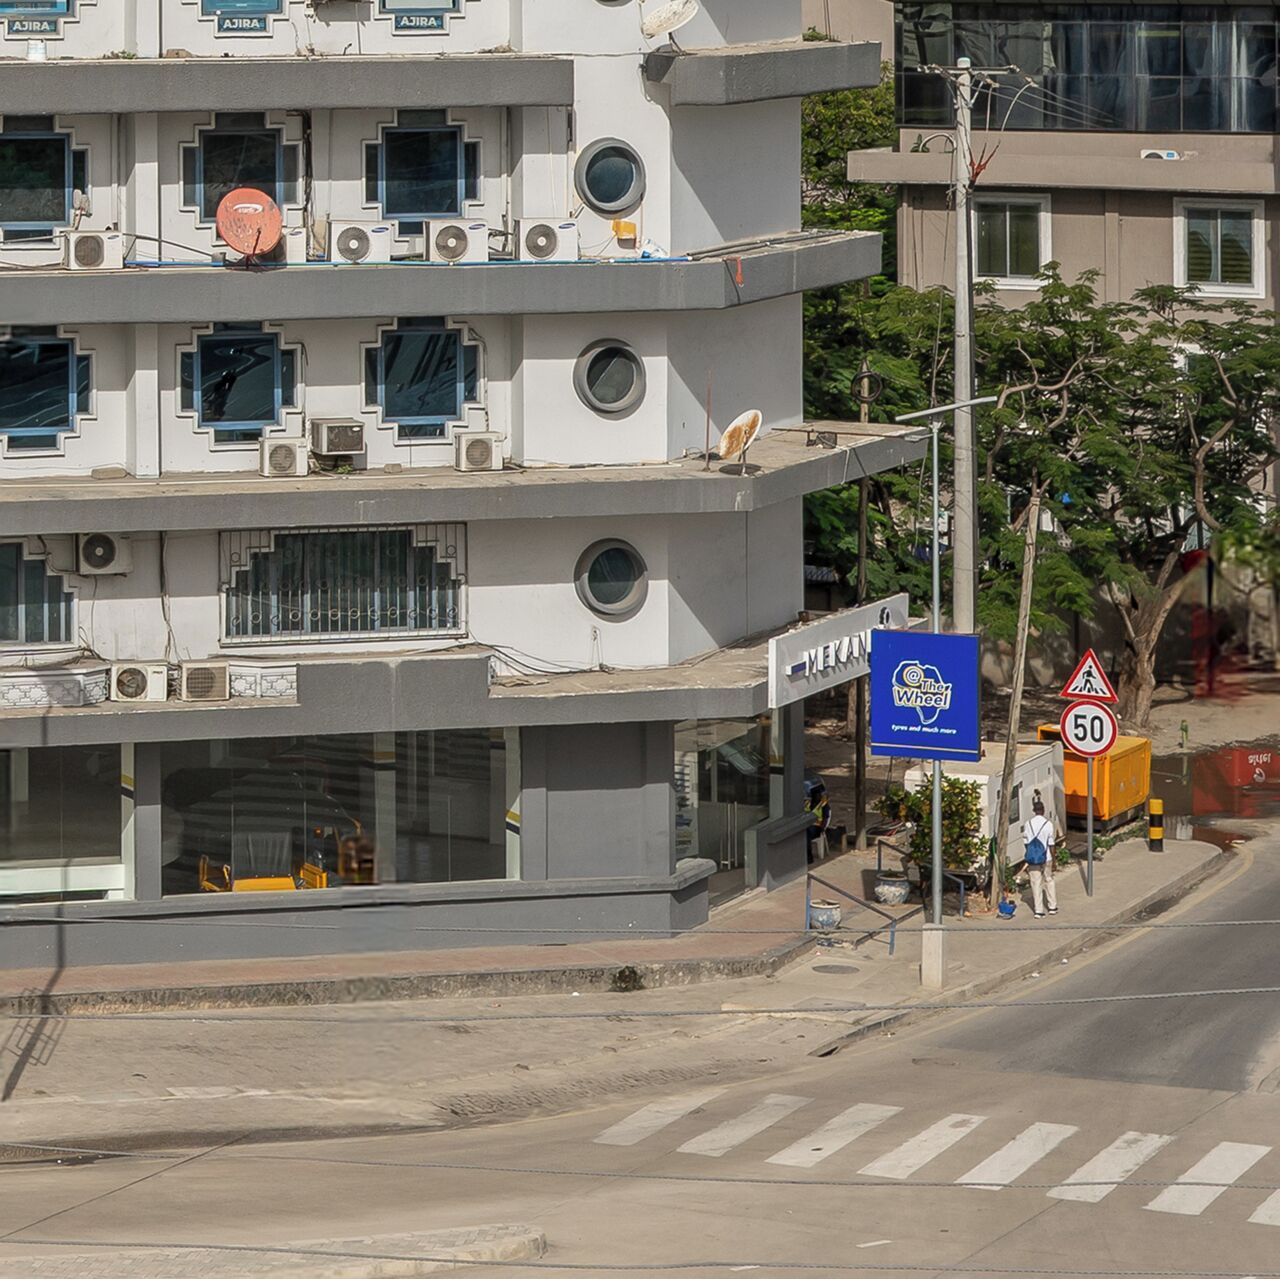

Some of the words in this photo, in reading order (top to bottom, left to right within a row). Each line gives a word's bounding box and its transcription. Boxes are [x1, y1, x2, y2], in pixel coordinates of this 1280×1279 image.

[12, 21, 50, 31] AJIRA
[223, 18, 260, 29] AJIRA
[400, 16, 438, 27] AJIRA
[803, 629, 872, 676] MEKAN
[921, 680, 945, 693] The
[896, 688, 948, 707] Wheel
[1073, 713, 1104, 743] 50
